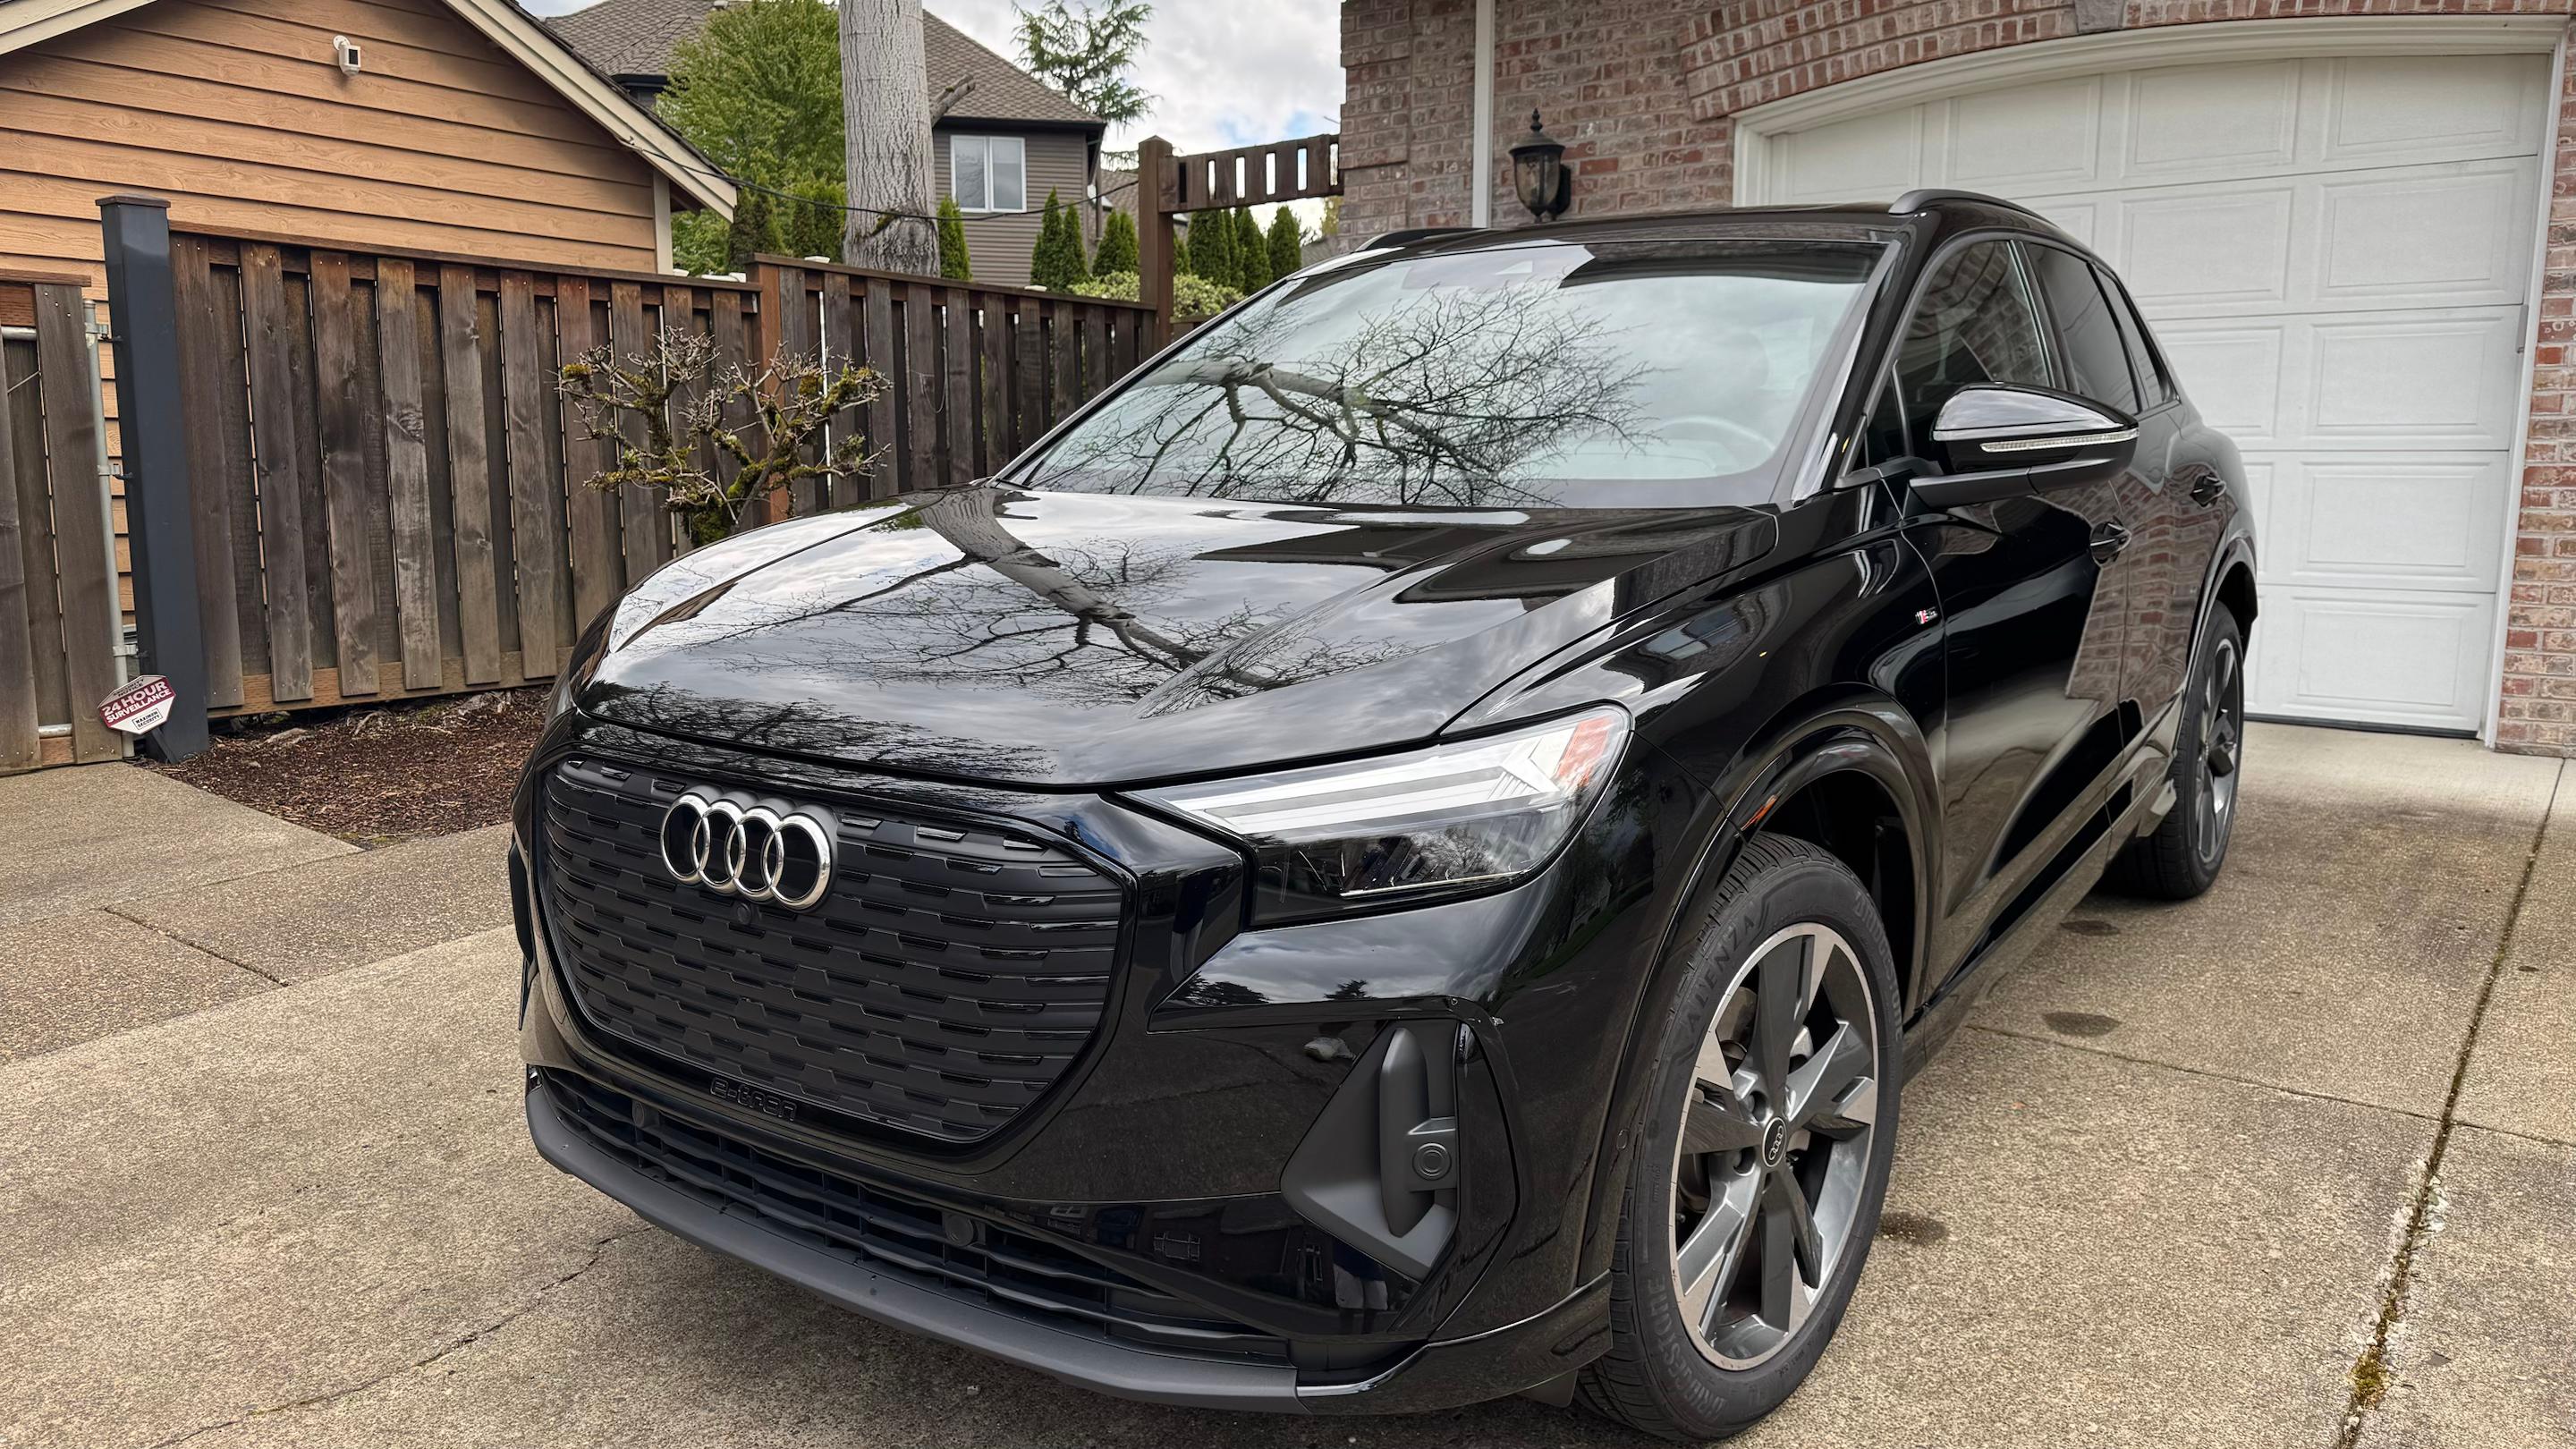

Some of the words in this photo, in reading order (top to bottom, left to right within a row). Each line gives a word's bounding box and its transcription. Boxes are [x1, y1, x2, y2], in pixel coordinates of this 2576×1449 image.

[102, 702, 122, 716] 24
[120, 681, 168, 708] HOUR
[106, 688, 172, 724] SURVEILLANCE
[138, 715, 160, 727] SECURITY
[1686, 914, 1756, 1034] ALENZA
[710, 1076, 796, 1122] e-tron
